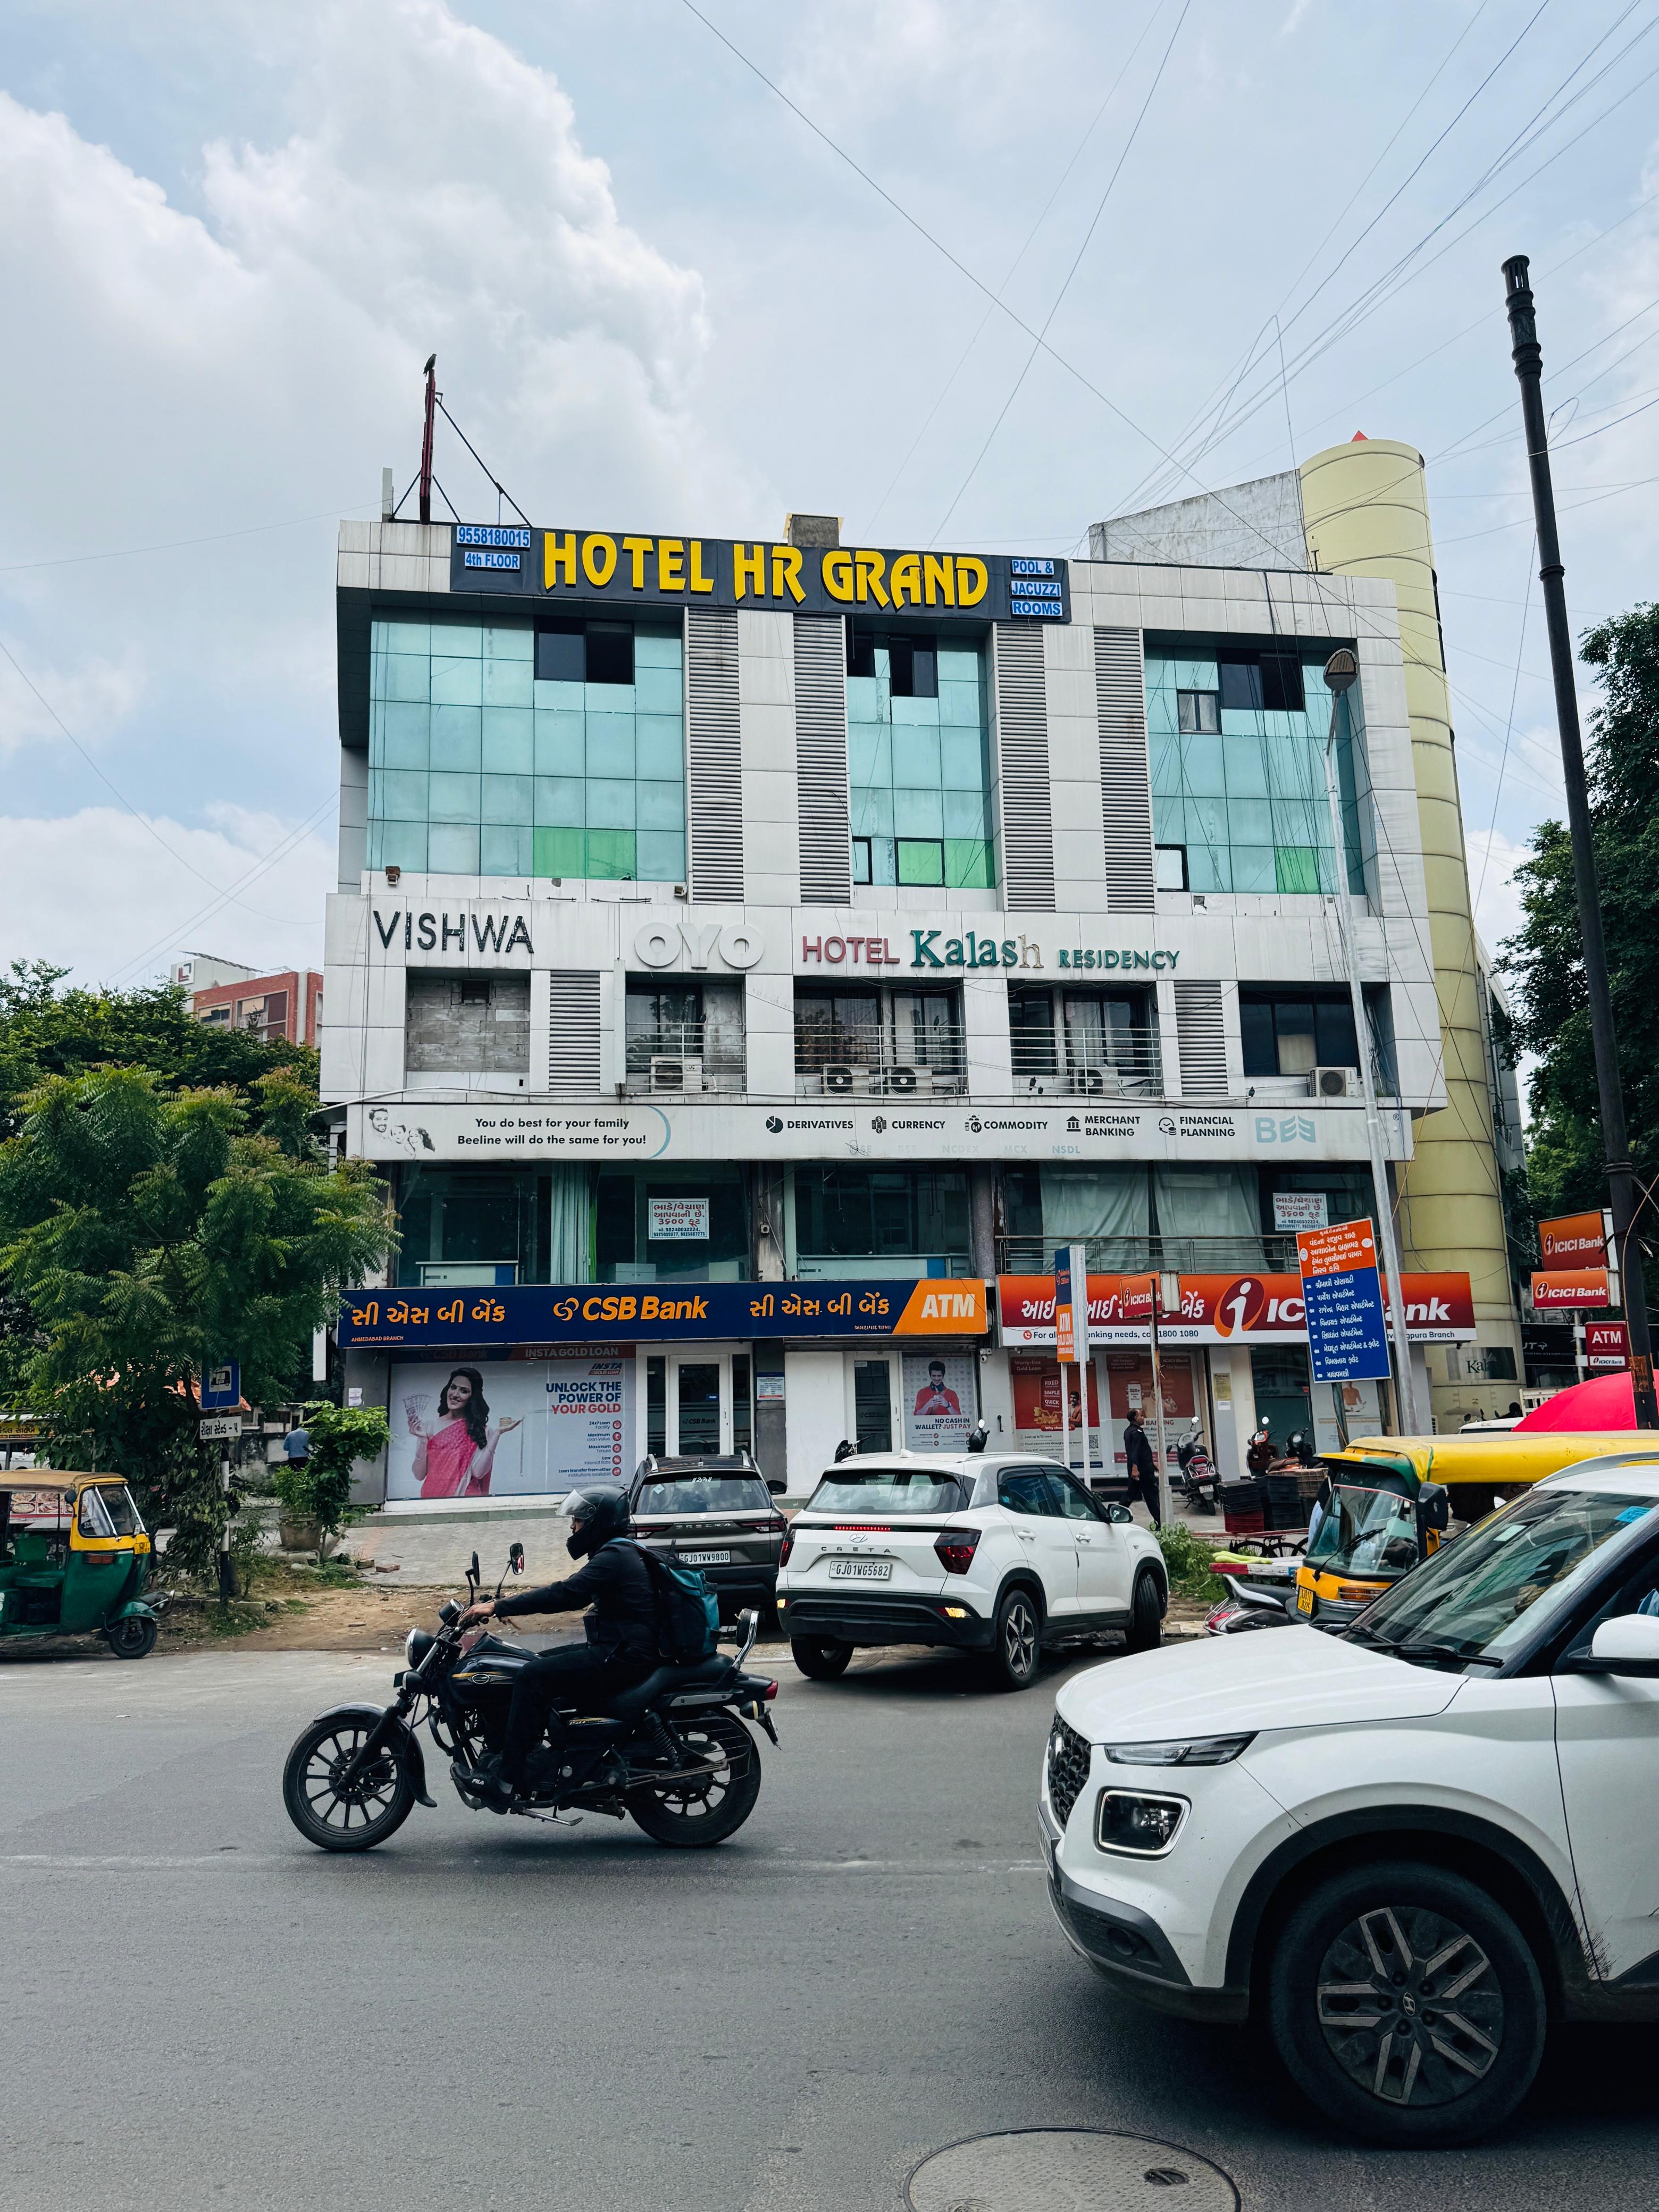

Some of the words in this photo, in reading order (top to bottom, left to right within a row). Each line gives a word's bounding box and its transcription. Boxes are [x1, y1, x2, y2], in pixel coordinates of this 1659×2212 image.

[458, 526, 530, 547] 9558180015
[465, 552, 482, 566] 4th
[484, 554, 518, 568] FLOOR
[544, 532, 714, 592] HOTEL
[733, 543, 806, 603] HR
[822, 550, 988, 609] GRAND
[1012, 559, 1042, 575] POOL
[1045, 564, 1053, 574] &
[1011, 581, 1061, 597] JACUZZI
[1012, 601, 1061, 615] ROOMS
[373, 910, 534, 953] VISHWA
[634, 921, 765, 969] OYO
[802, 936, 900, 964] HOTEL
[910, 930, 1044, 968] Kalash
[1058, 949, 1180, 969] RESIDENCY
[475, 1118, 496, 1128] You
[500, 1118, 515, 1127] do
[518, 1118, 542, 1127] best
[546, 1118, 562, 1127] for
[565, 1120, 591, 1130] your
[594, 1118, 630, 1130] family
[787, 1120, 854, 1129] DERIVATIVES
[892, 1120, 945, 1129] CURRENCY
[984, 1120, 1048, 1130] COMMODITY
[1084, 1116, 1141, 1125] MERCHANT
[1179, 1116, 1234, 1125] FINANCIAL
[1085, 1128, 1135, 1136] BANKING
[1180, 1128, 1235, 1136] PLANNING
[457, 1135, 501, 1145] Beeline
[505, 1135, 525, 1145] will
[529, 1135, 543, 1145] do
[547, 1135, 565, 1145] the
[602, 1135, 619, 1145] for
[622, 1135, 647, 1146] you!
[942, 1145, 979, 1153] NCDEX
[1052, 1145, 1080, 1154] NSDL
[1555, 1239, 1577, 1253] ICICI
[1580, 1236, 1604, 1249] Bank
[1548, 1288, 1576, 1298] ICICI
[1577, 1287, 1606, 1297] Bank
[750, 1294, 774, 1317] સી
[781, 1293, 819, 1316] એસ
[827, 1293, 852, 1316] બી
[859, 1292, 890, 1316] બેંક
[1130, 1293, 1146, 1305] ICICI
[351, 1302, 379, 1326] સી
[387, 1301, 429, 1324] એસ
[437, 1300, 464, 1323] બી
[472, 1298, 506, 1322] બેંક
[582, 1296, 638, 1321] CSB
[640, 1296, 709, 1320] Bank
[920, 1294, 975, 1318] ATM
[1115, 1330, 1140, 1339] needs,
[1591, 1330, 1622, 1344] ATM
[525, 1349, 557, 1358] INSTA
[559, 1348, 588, 1357] GOLD
[589, 1347, 619, 1356] LOAN
[546, 1382, 597, 1393] UNLOCK
[599, 1381, 622, 1392] THE
[559, 1393, 604, 1403] POWER
[605, 1392, 622, 1402] OF
[551, 1404, 586, 1414] YOUR
[588, 1403, 622, 1413] GOLD
[836, 1564, 889, 1577] GJ01WG5682
